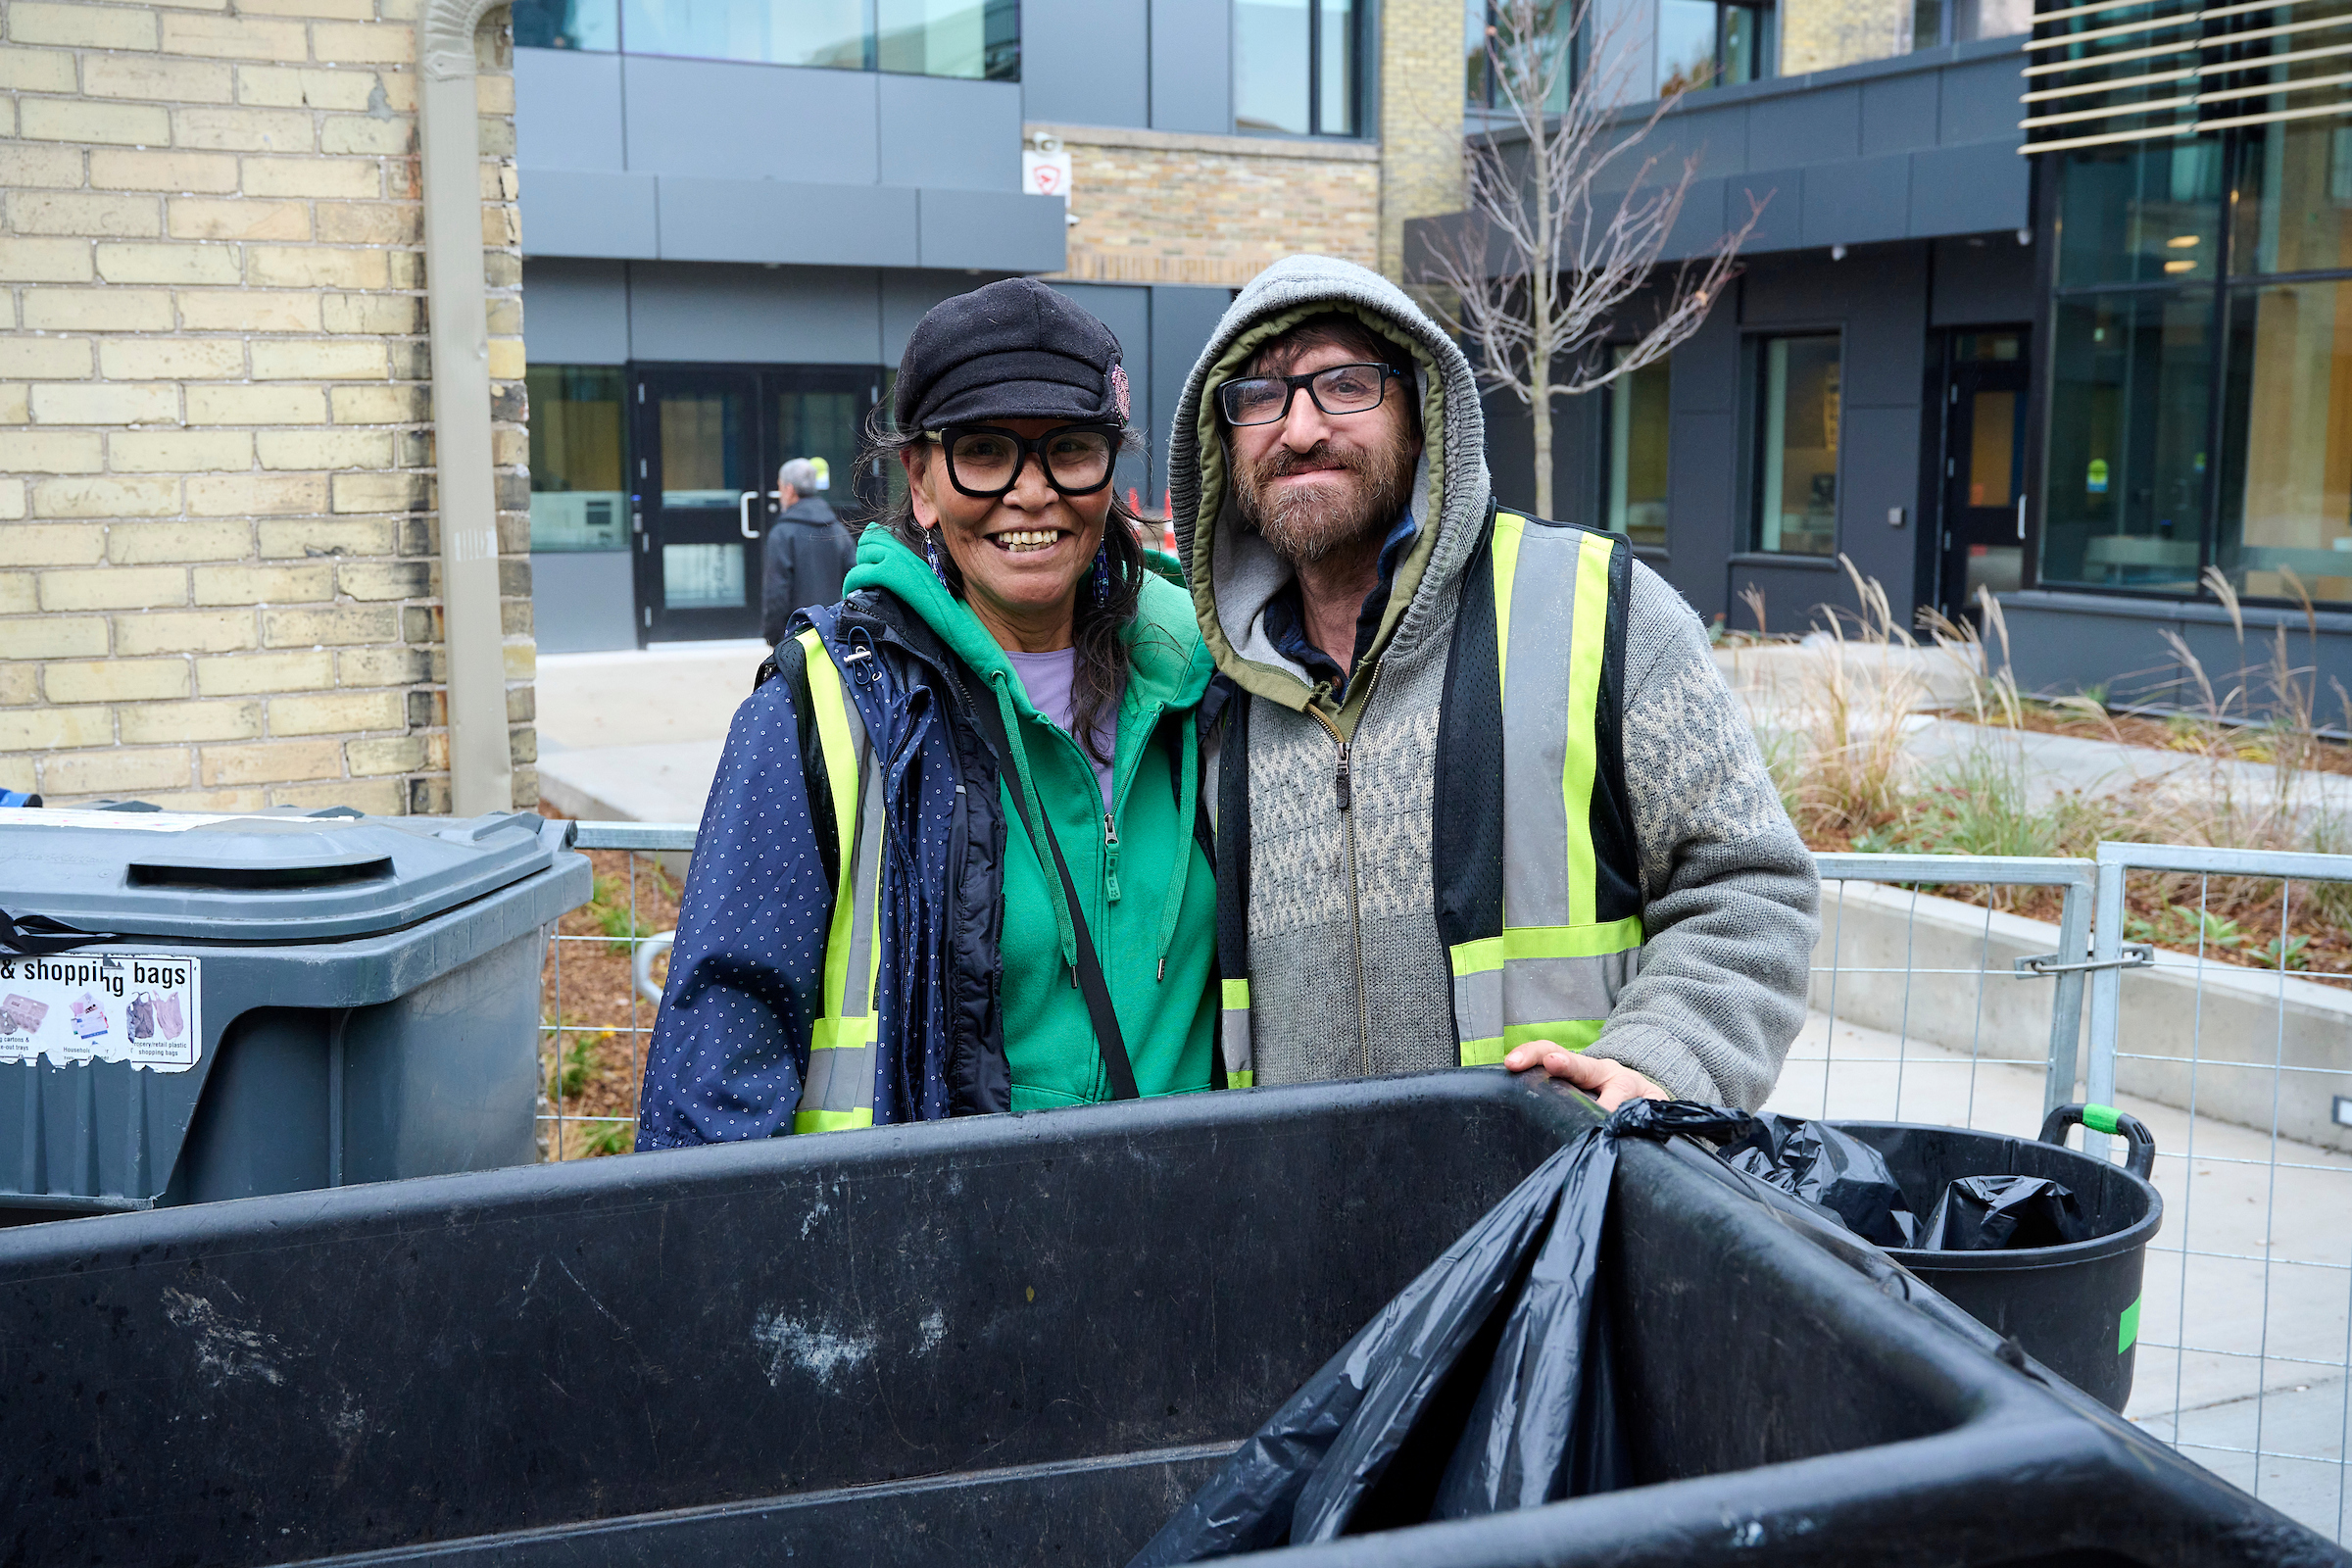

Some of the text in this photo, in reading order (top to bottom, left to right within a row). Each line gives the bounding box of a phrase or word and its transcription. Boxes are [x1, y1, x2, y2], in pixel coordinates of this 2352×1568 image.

[1, 959, 185, 997] & shopping bags
